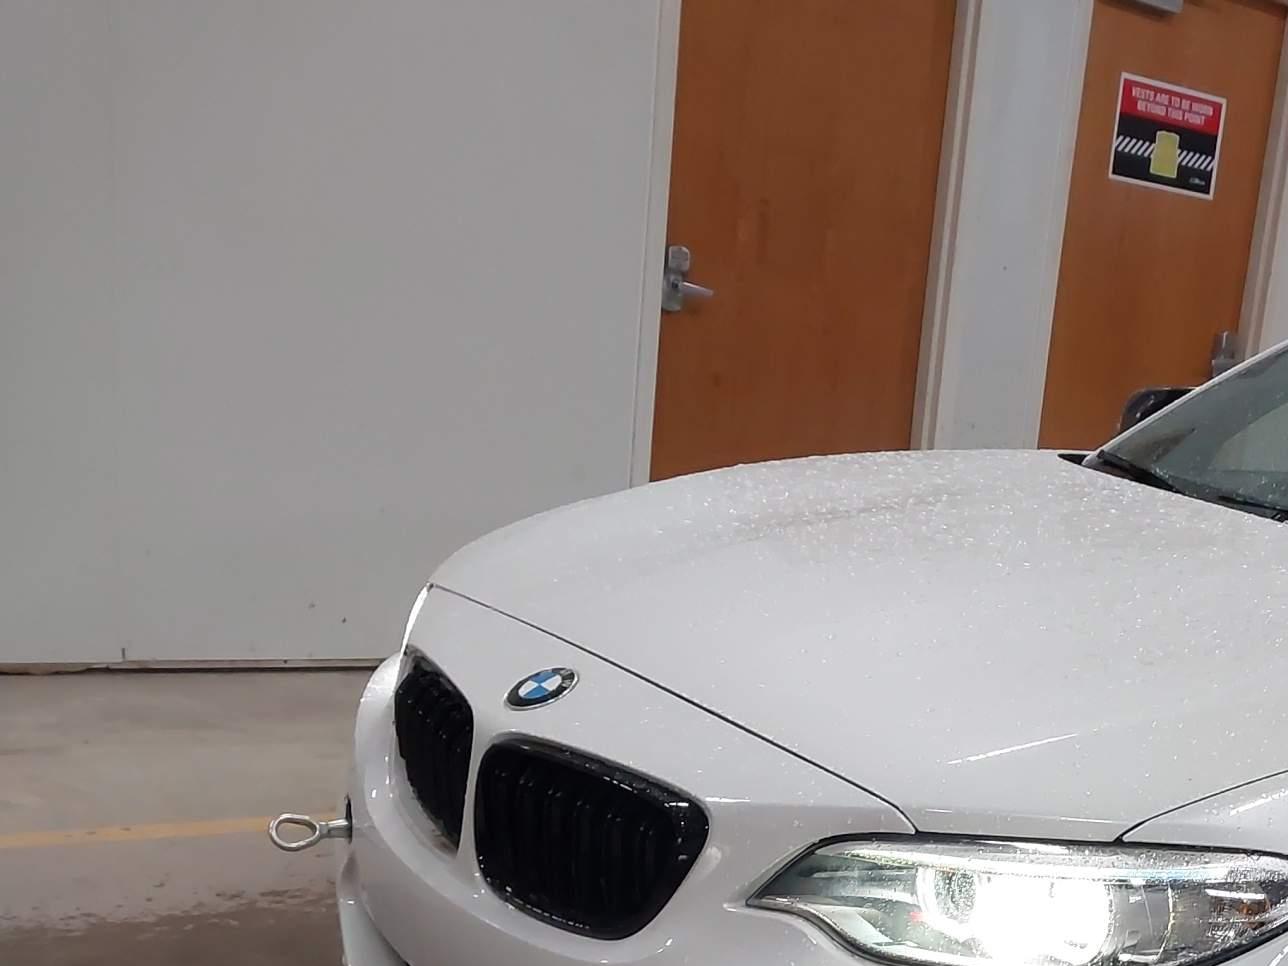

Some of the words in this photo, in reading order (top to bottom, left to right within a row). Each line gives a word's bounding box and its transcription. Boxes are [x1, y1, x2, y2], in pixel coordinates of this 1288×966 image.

[1131, 87, 1155, 101] VESTS
[1155, 92, 1170, 106] ARE
[1171, 95, 1181, 109] TO
[1181, 98, 1191, 111] BE
[1137, 99, 1167, 116] BEYOND
[1167, 106, 1184, 121] THIS
[1184, 110, 1206, 126] POINT
